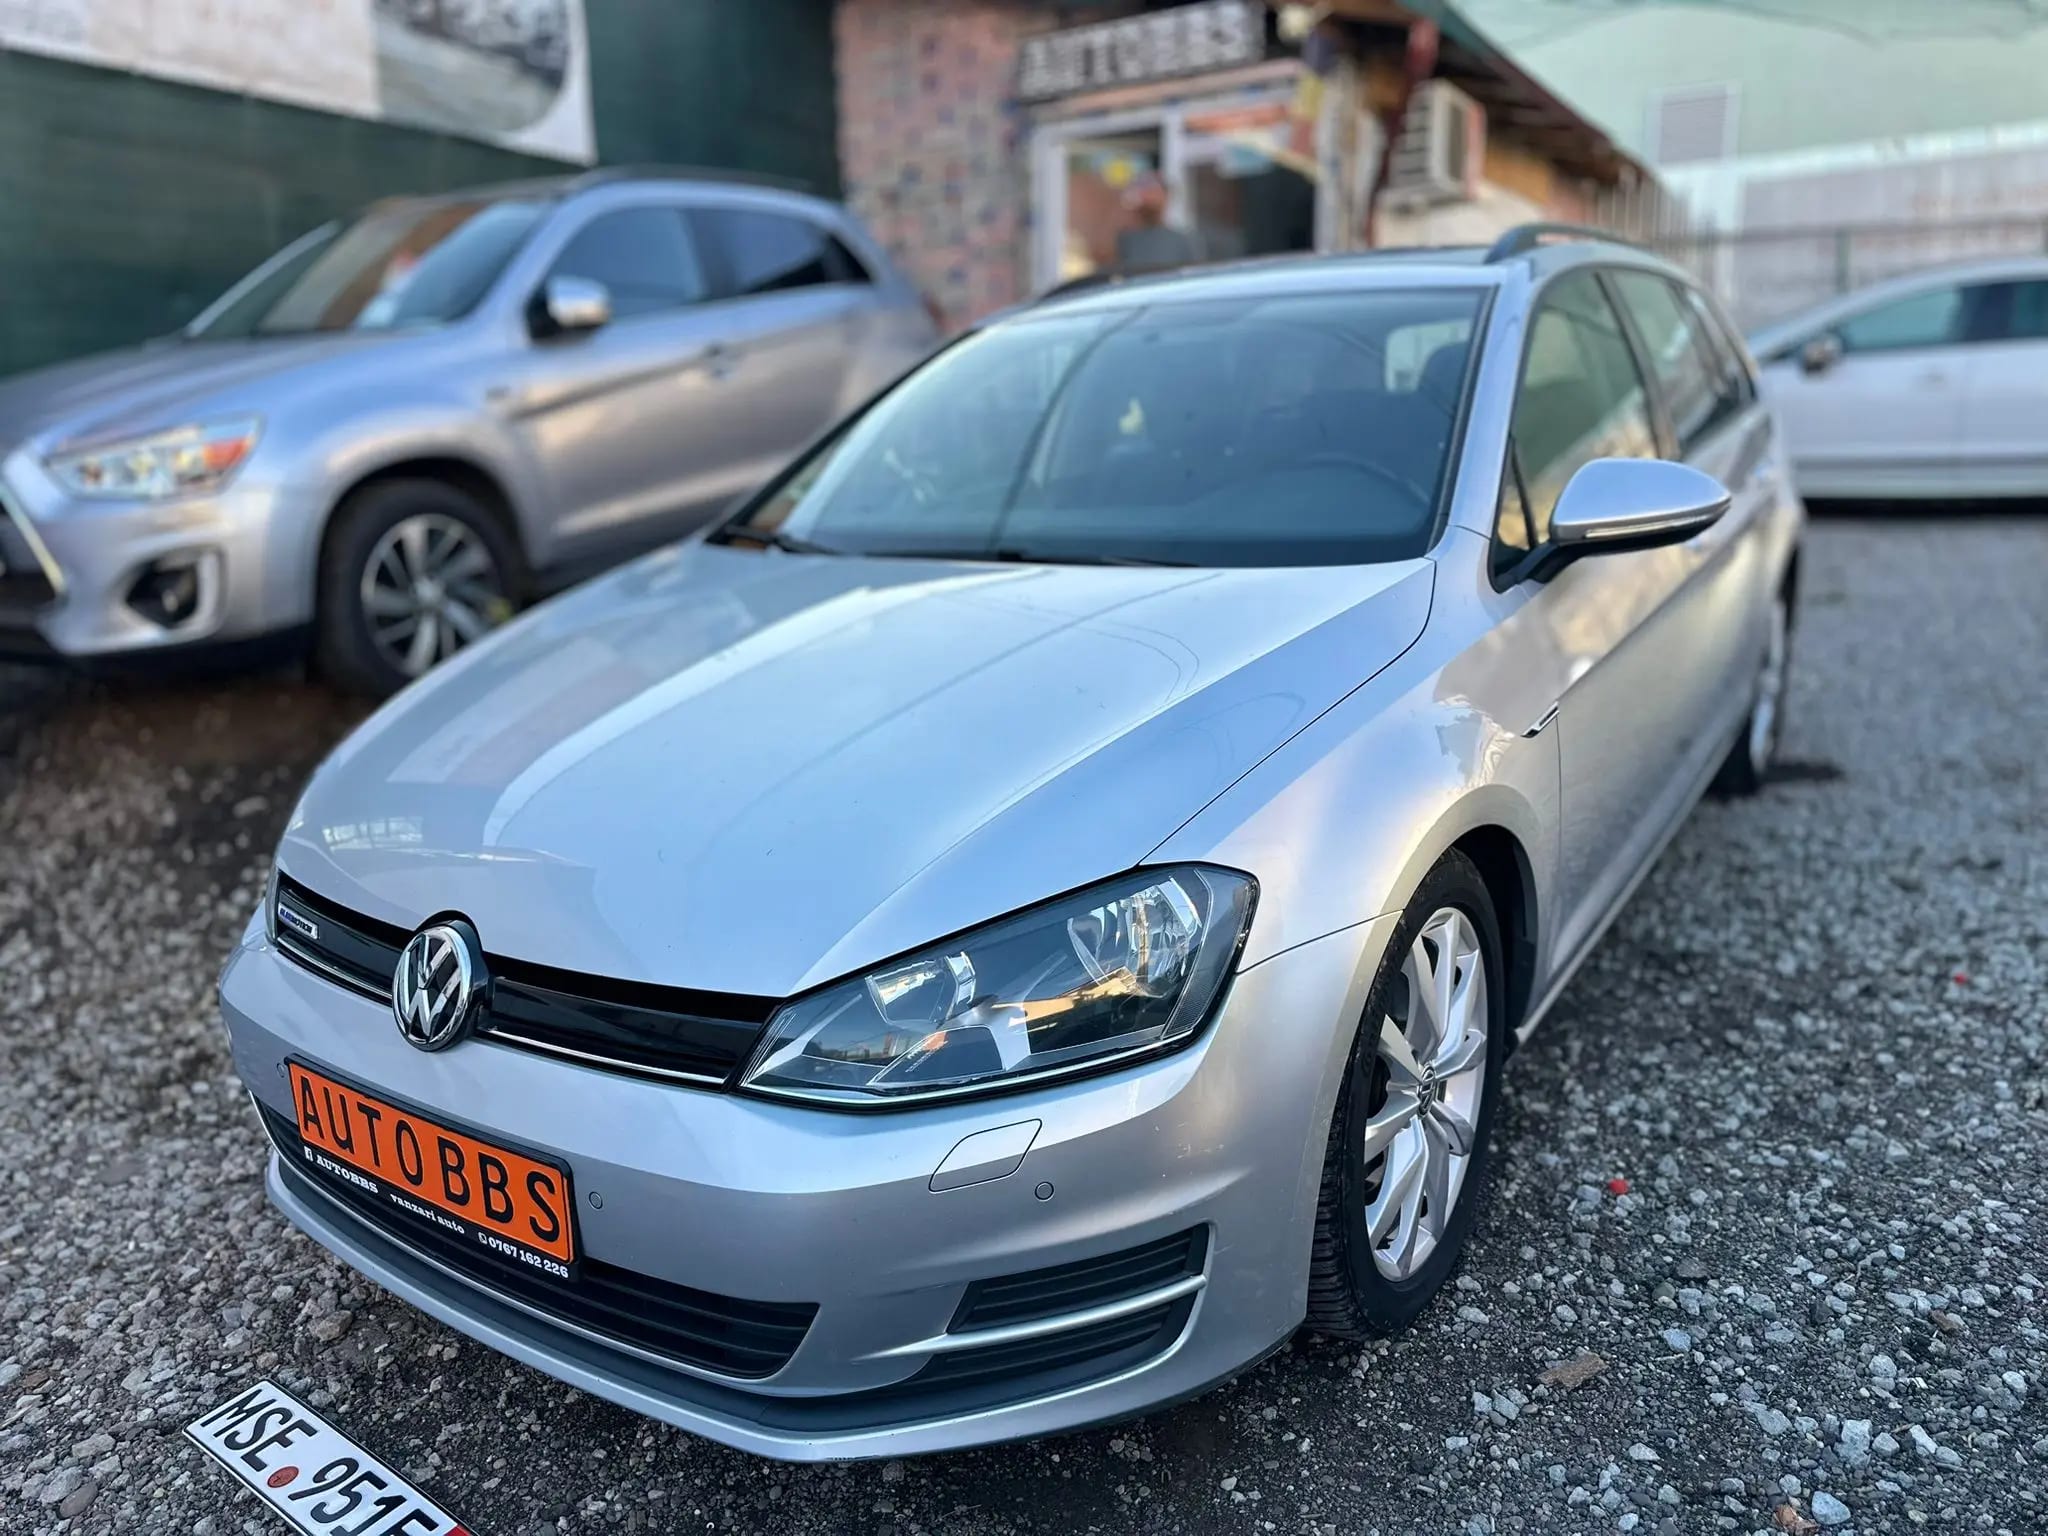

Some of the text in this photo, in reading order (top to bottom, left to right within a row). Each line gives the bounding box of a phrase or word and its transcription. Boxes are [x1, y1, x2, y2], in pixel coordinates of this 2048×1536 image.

[316, 1153, 465, 1235] AUTOBBS vanzari auto
[488, 1236, 569, 1279] 0767 162 226
[200, 1389, 318, 1473] MSE
